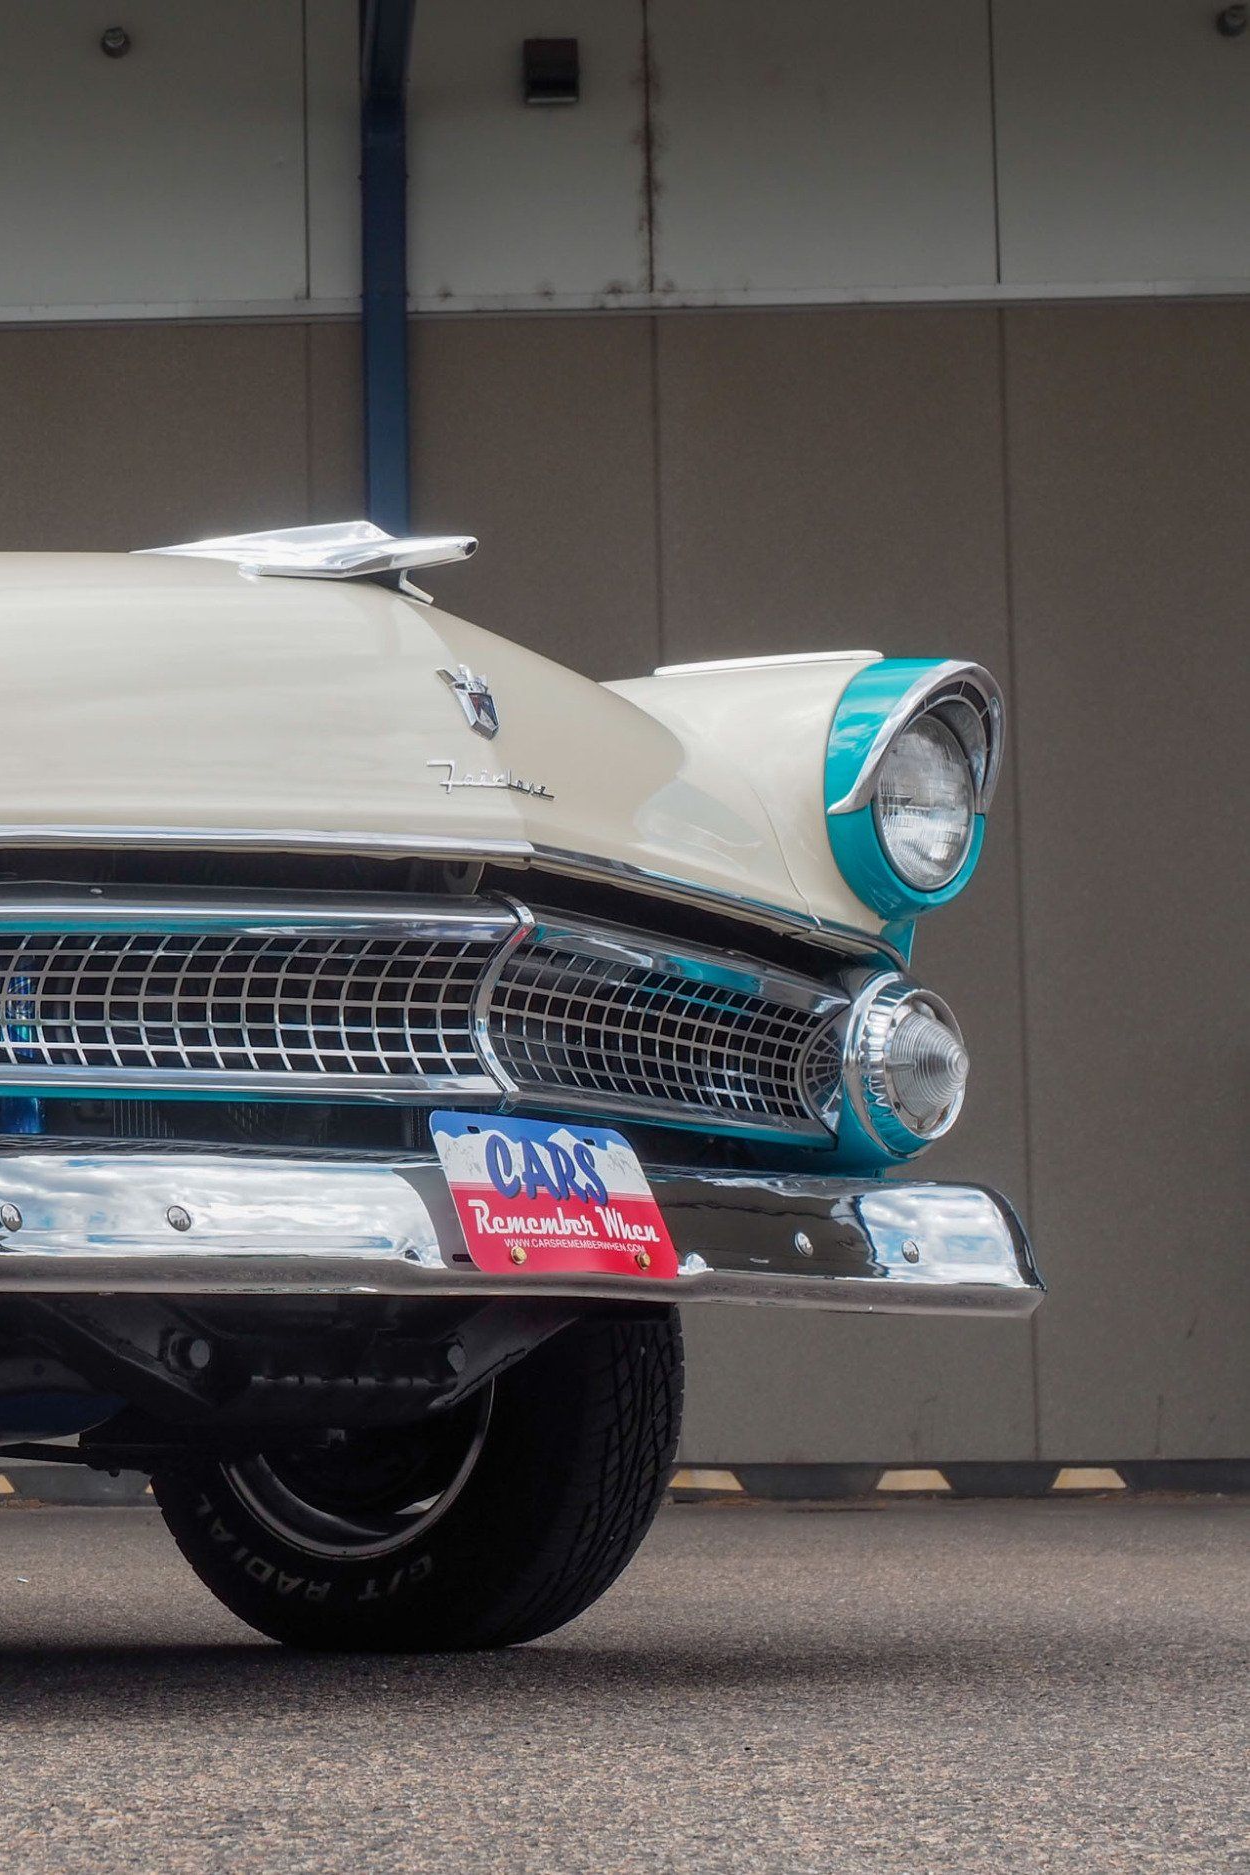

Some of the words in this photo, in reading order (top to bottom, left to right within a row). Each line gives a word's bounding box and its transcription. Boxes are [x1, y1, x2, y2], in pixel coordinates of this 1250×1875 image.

[485, 1133, 608, 1206] CARS
[468, 1199, 599, 1236] Remember
[595, 1206, 661, 1243] When
[503, 1238, 646, 1253] WWW.CARSREMEMBERWHEN.COM
[195, 1493, 332, 1603] RADIAL
